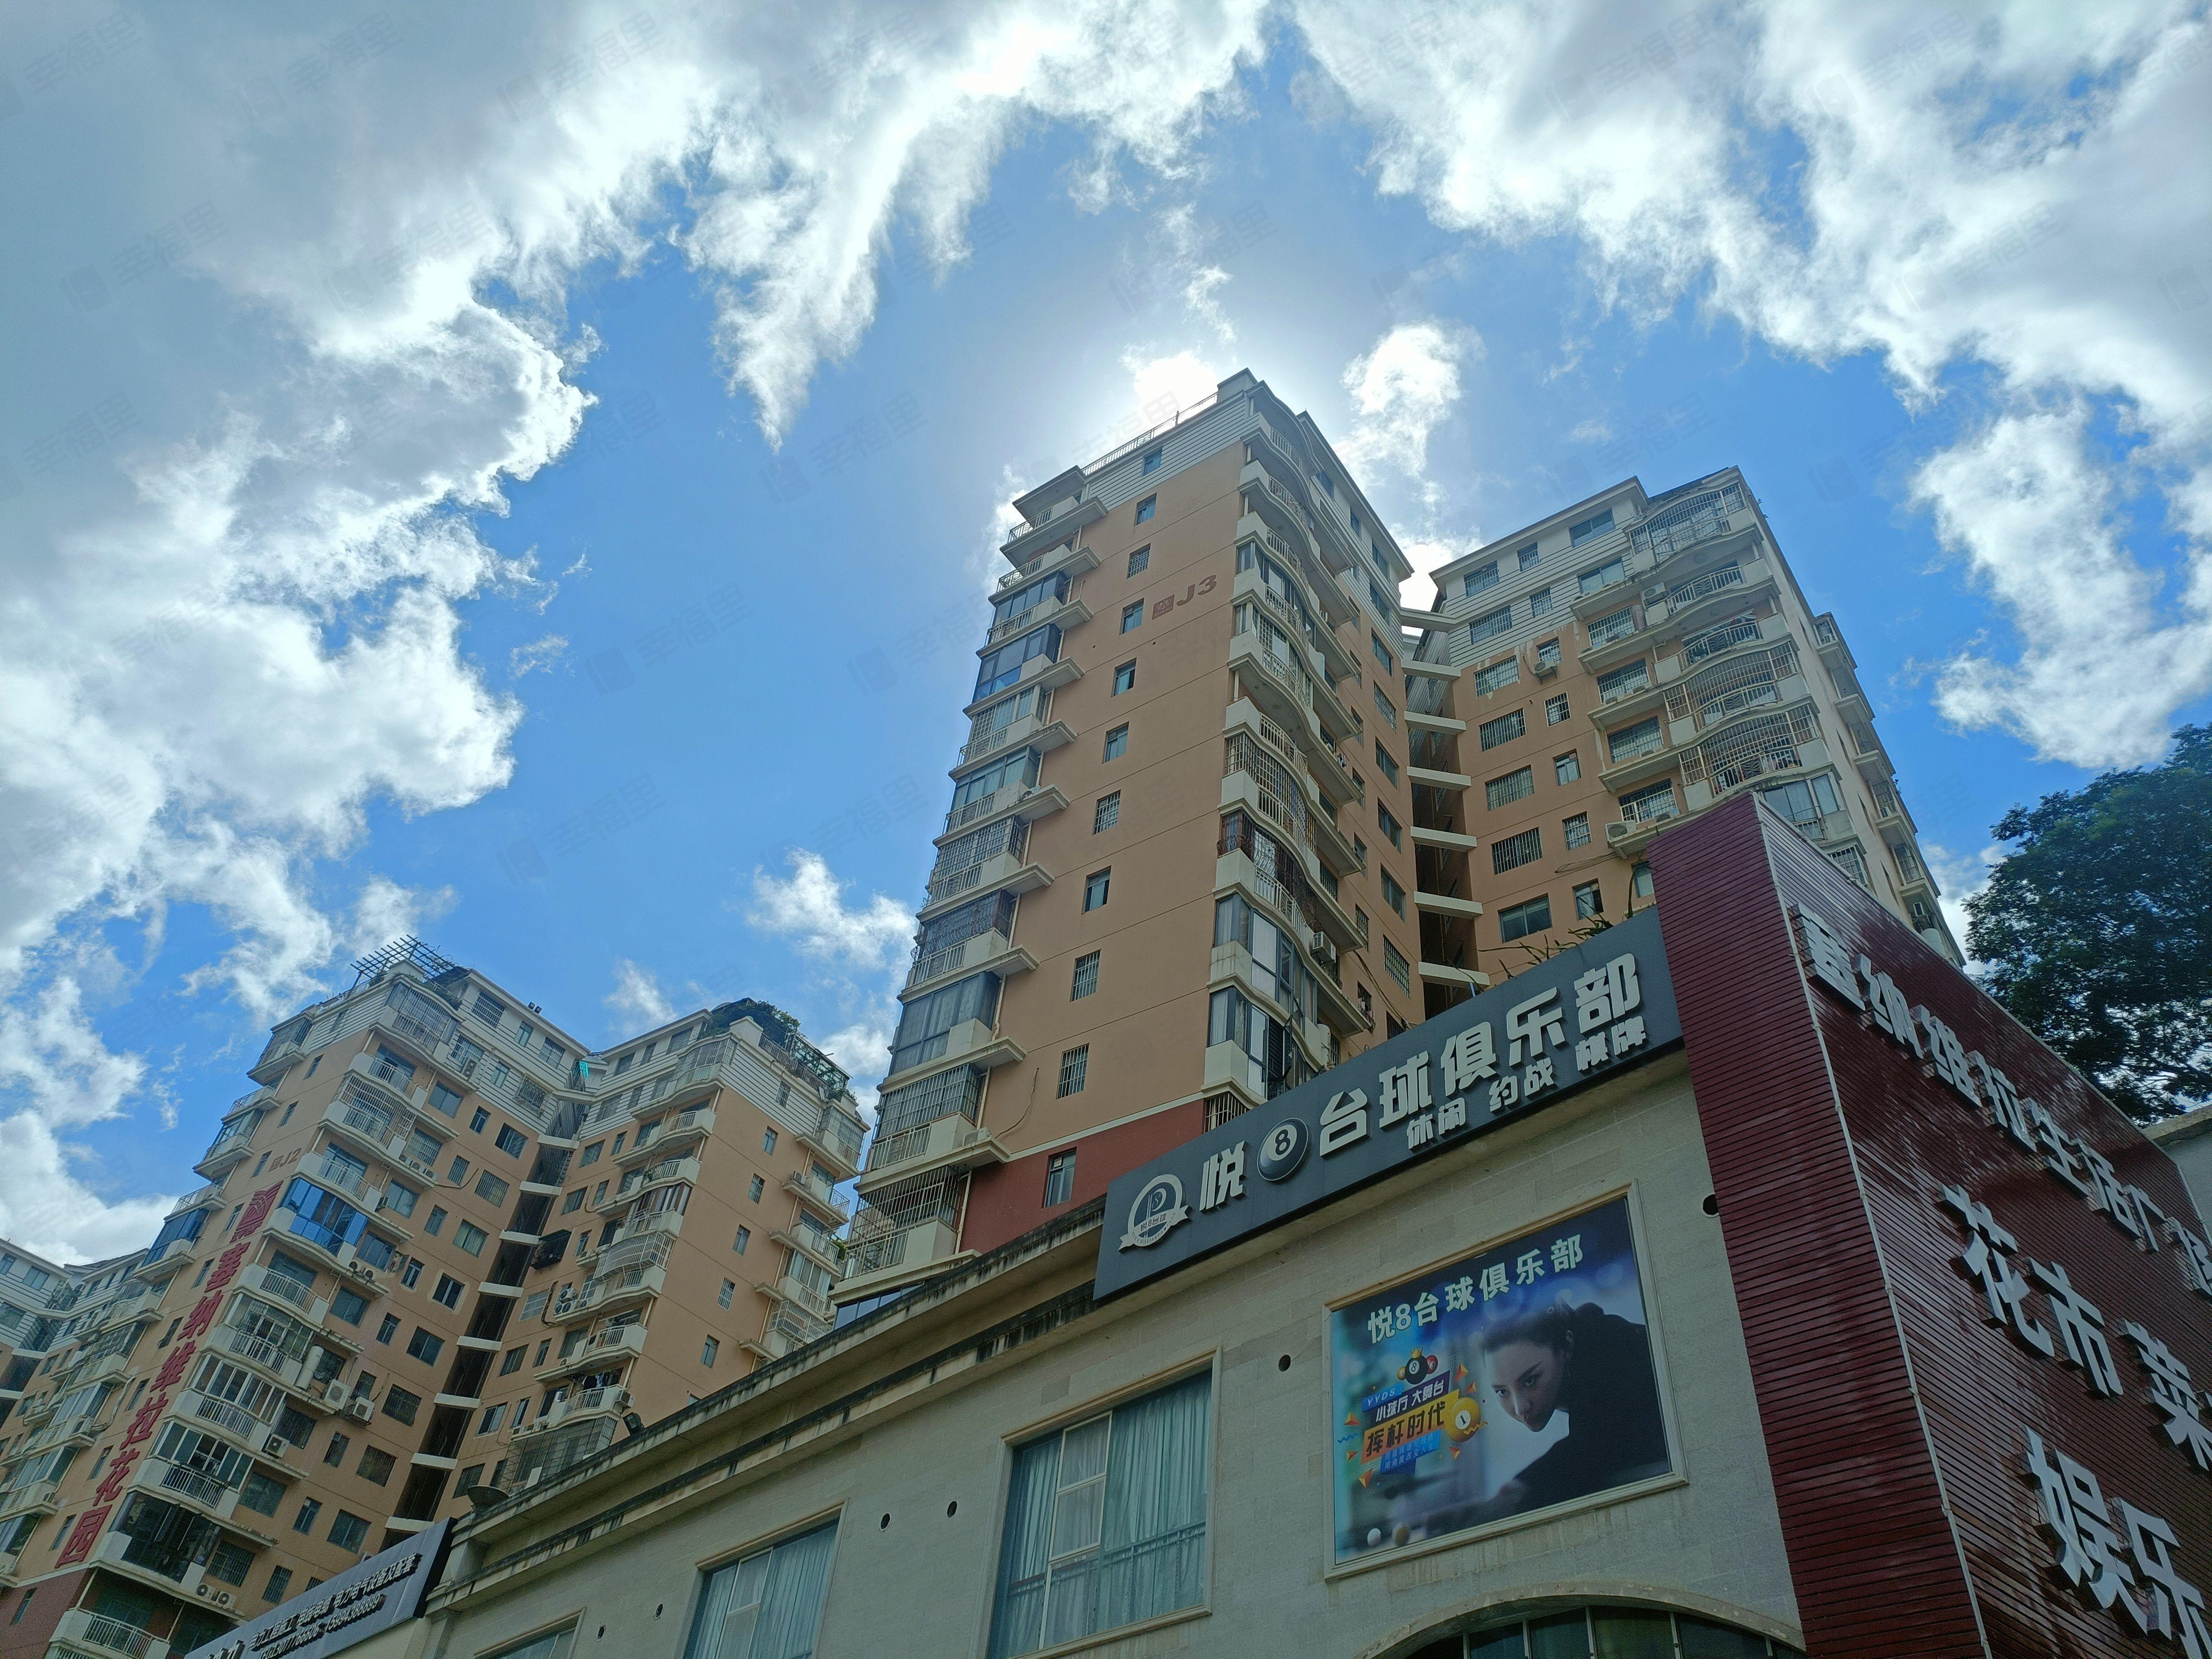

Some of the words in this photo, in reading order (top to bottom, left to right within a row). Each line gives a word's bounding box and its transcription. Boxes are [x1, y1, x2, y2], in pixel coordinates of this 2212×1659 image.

[1176, 575, 1217, 606] J3
[1406, 1097, 1466, 1150] 休闲
[1489, 1057, 1556, 1112] 约战
[1575, 1016, 1647, 1071] 棋牌
[279, 1148, 302, 1168] J2
[1368, 1234, 1583, 1344] 悦8台球俱乐部
[1941, 1183, 2124, 1397] 花市
[1411, 1362, 1416, 1372] 8
[55, 1242, 250, 1569] 塞纳维拉花园
[1367, 1388, 1395, 1407] YYDS
[1375, 1395, 1409, 1422] 小球厅
[1411, 1379, 1444, 1407] 大舞台
[1460, 1415, 1467, 1426] 1
[1366, 1401, 1446, 1457] 挥杆时代
[2025, 1425, 2212, 1659] 娱乐
